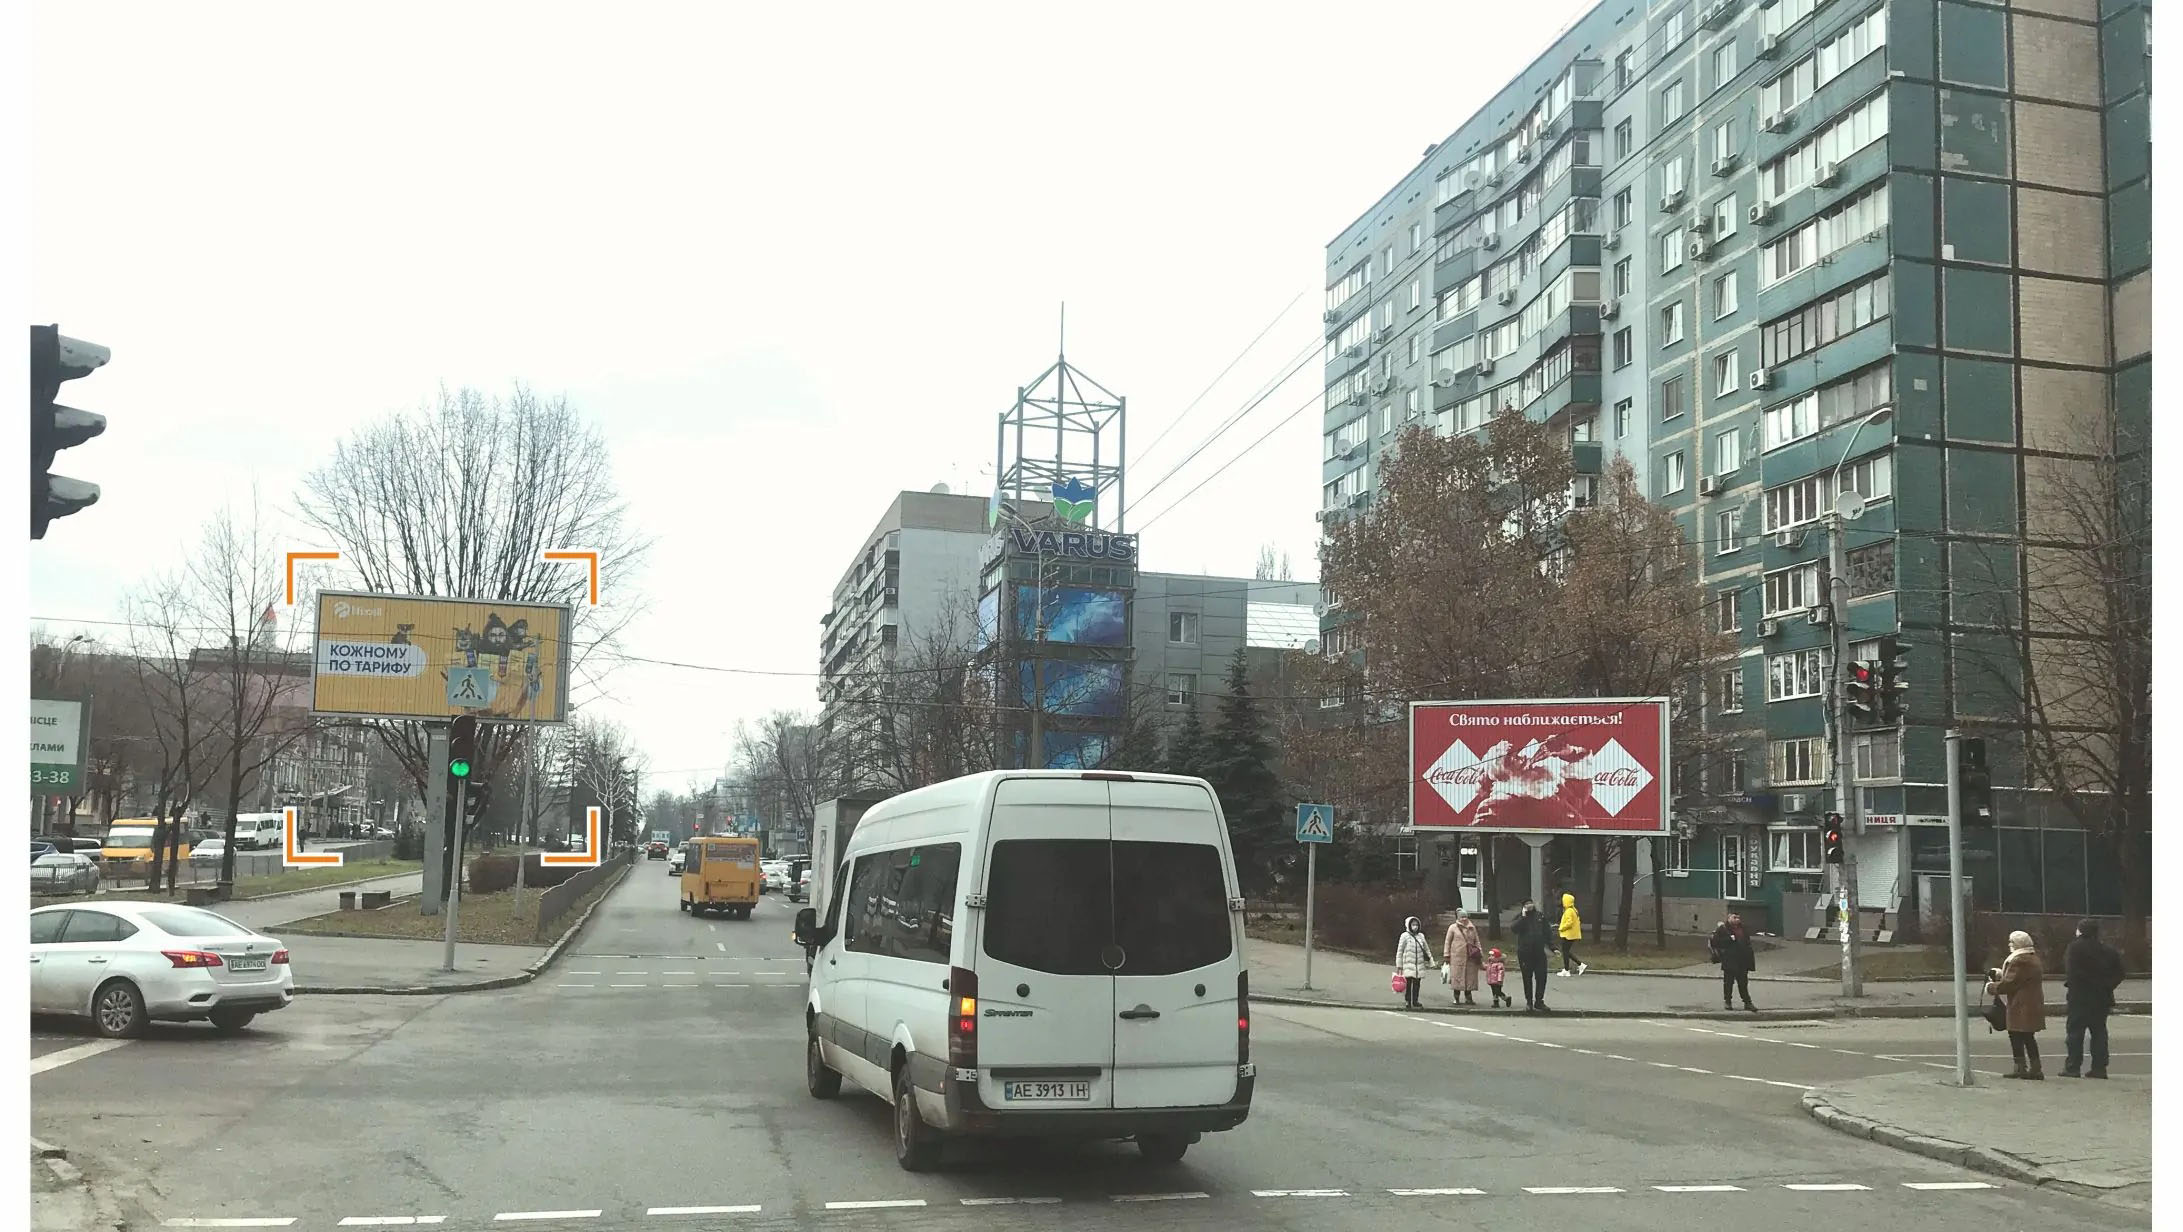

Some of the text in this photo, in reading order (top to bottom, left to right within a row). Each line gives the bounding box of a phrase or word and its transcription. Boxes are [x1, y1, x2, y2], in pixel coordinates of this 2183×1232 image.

[1010, 528, 1134, 560] VARUS
[330, 644, 408, 659] КОЖНОМУ
[329, 660, 412, 674] ПО ТАРИФУ
[1449, 711, 1623, 727] Свято наближається!
[1594, 767, 1641, 787] ca-Cola
[1014, 1084, 1033, 1098] AE
[1036, 1084, 1065, 1098] 3913
